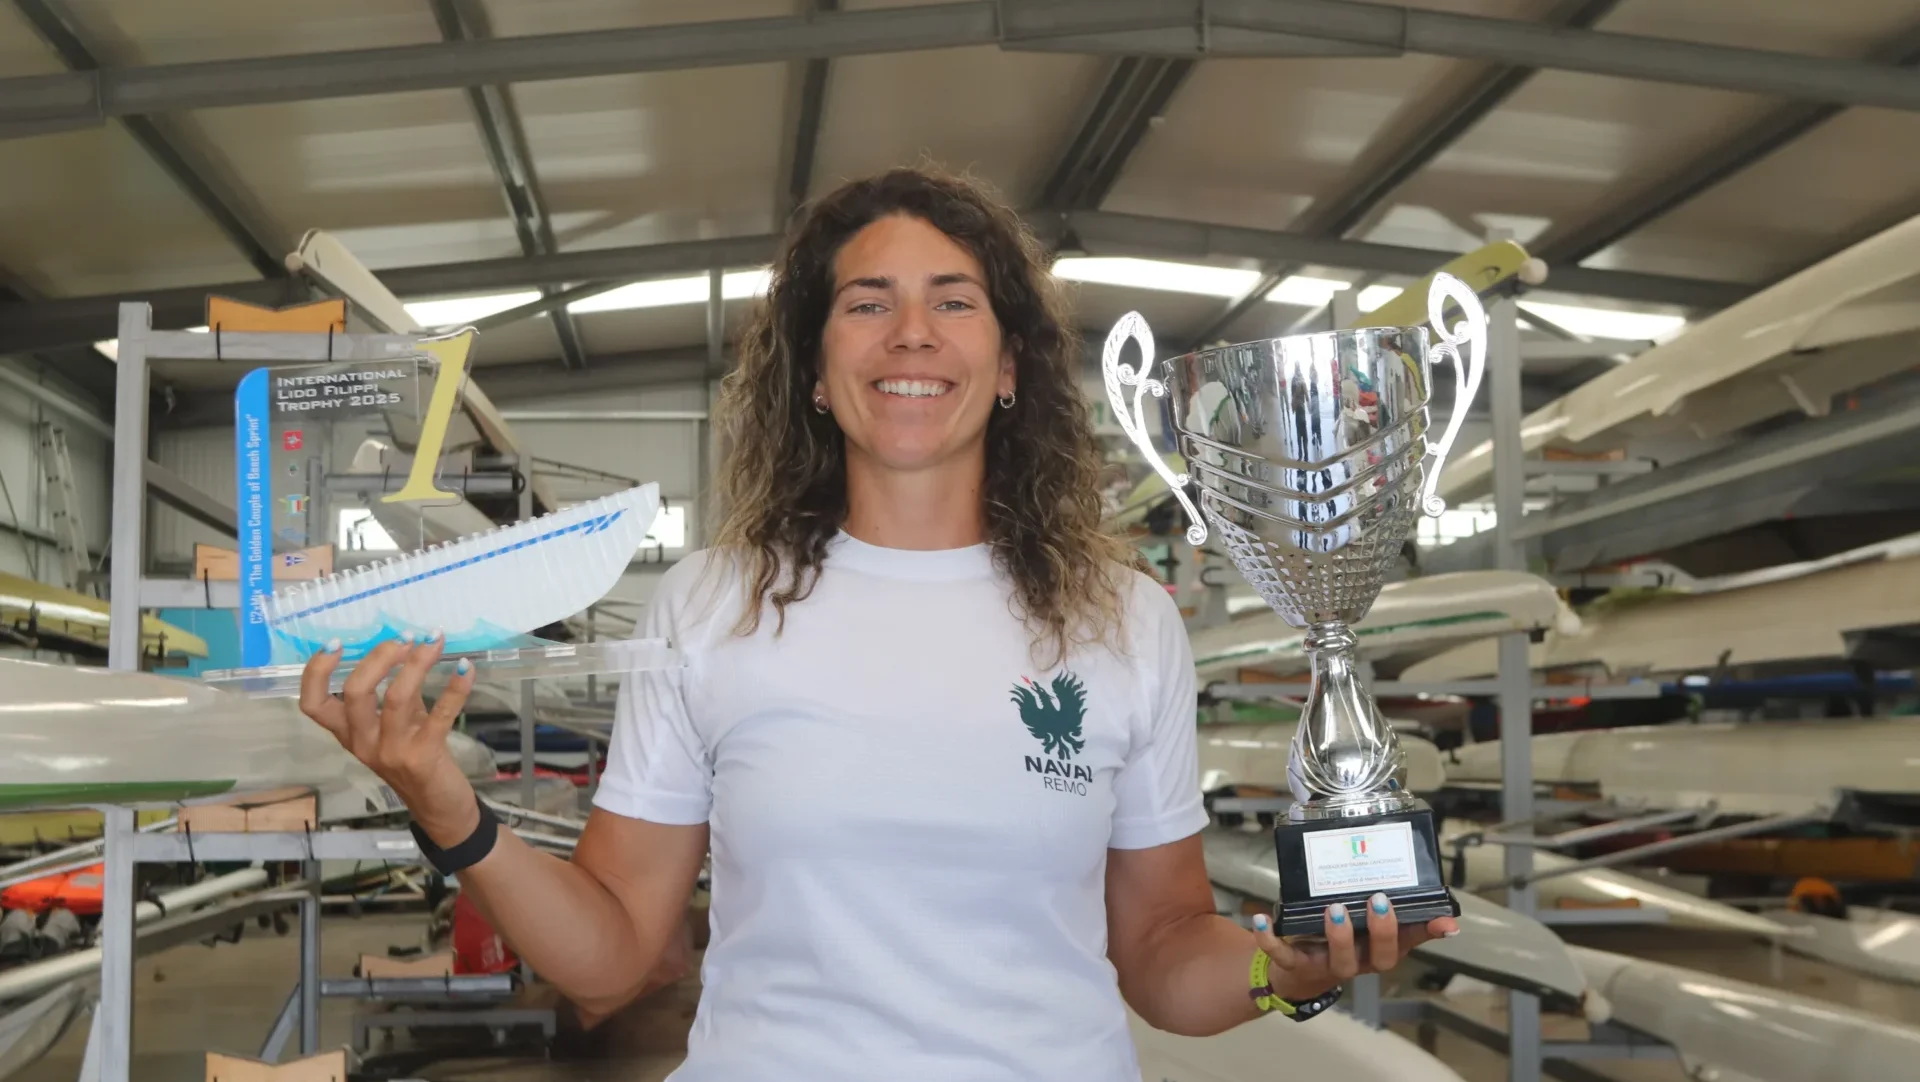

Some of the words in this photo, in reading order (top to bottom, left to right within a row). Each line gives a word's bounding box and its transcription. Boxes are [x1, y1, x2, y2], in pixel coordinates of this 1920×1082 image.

[276, 369, 407, 387] INTERNATIONAL
[276, 399, 343, 412] TROPHY
[350, 393, 401, 406] 2025
[277, 388, 318, 400] LIDO
[323, 384, 379, 396] FILIPPI
[381, 331, 473, 503] 1
[246, 450, 260, 480] Beach
[247, 482, 261, 492] of
[247, 494, 263, 527] Couple
[248, 529, 262, 562] Golden
[1024, 755, 1093, 783] NAVAL
[1043, 776, 1087, 797] REMO
